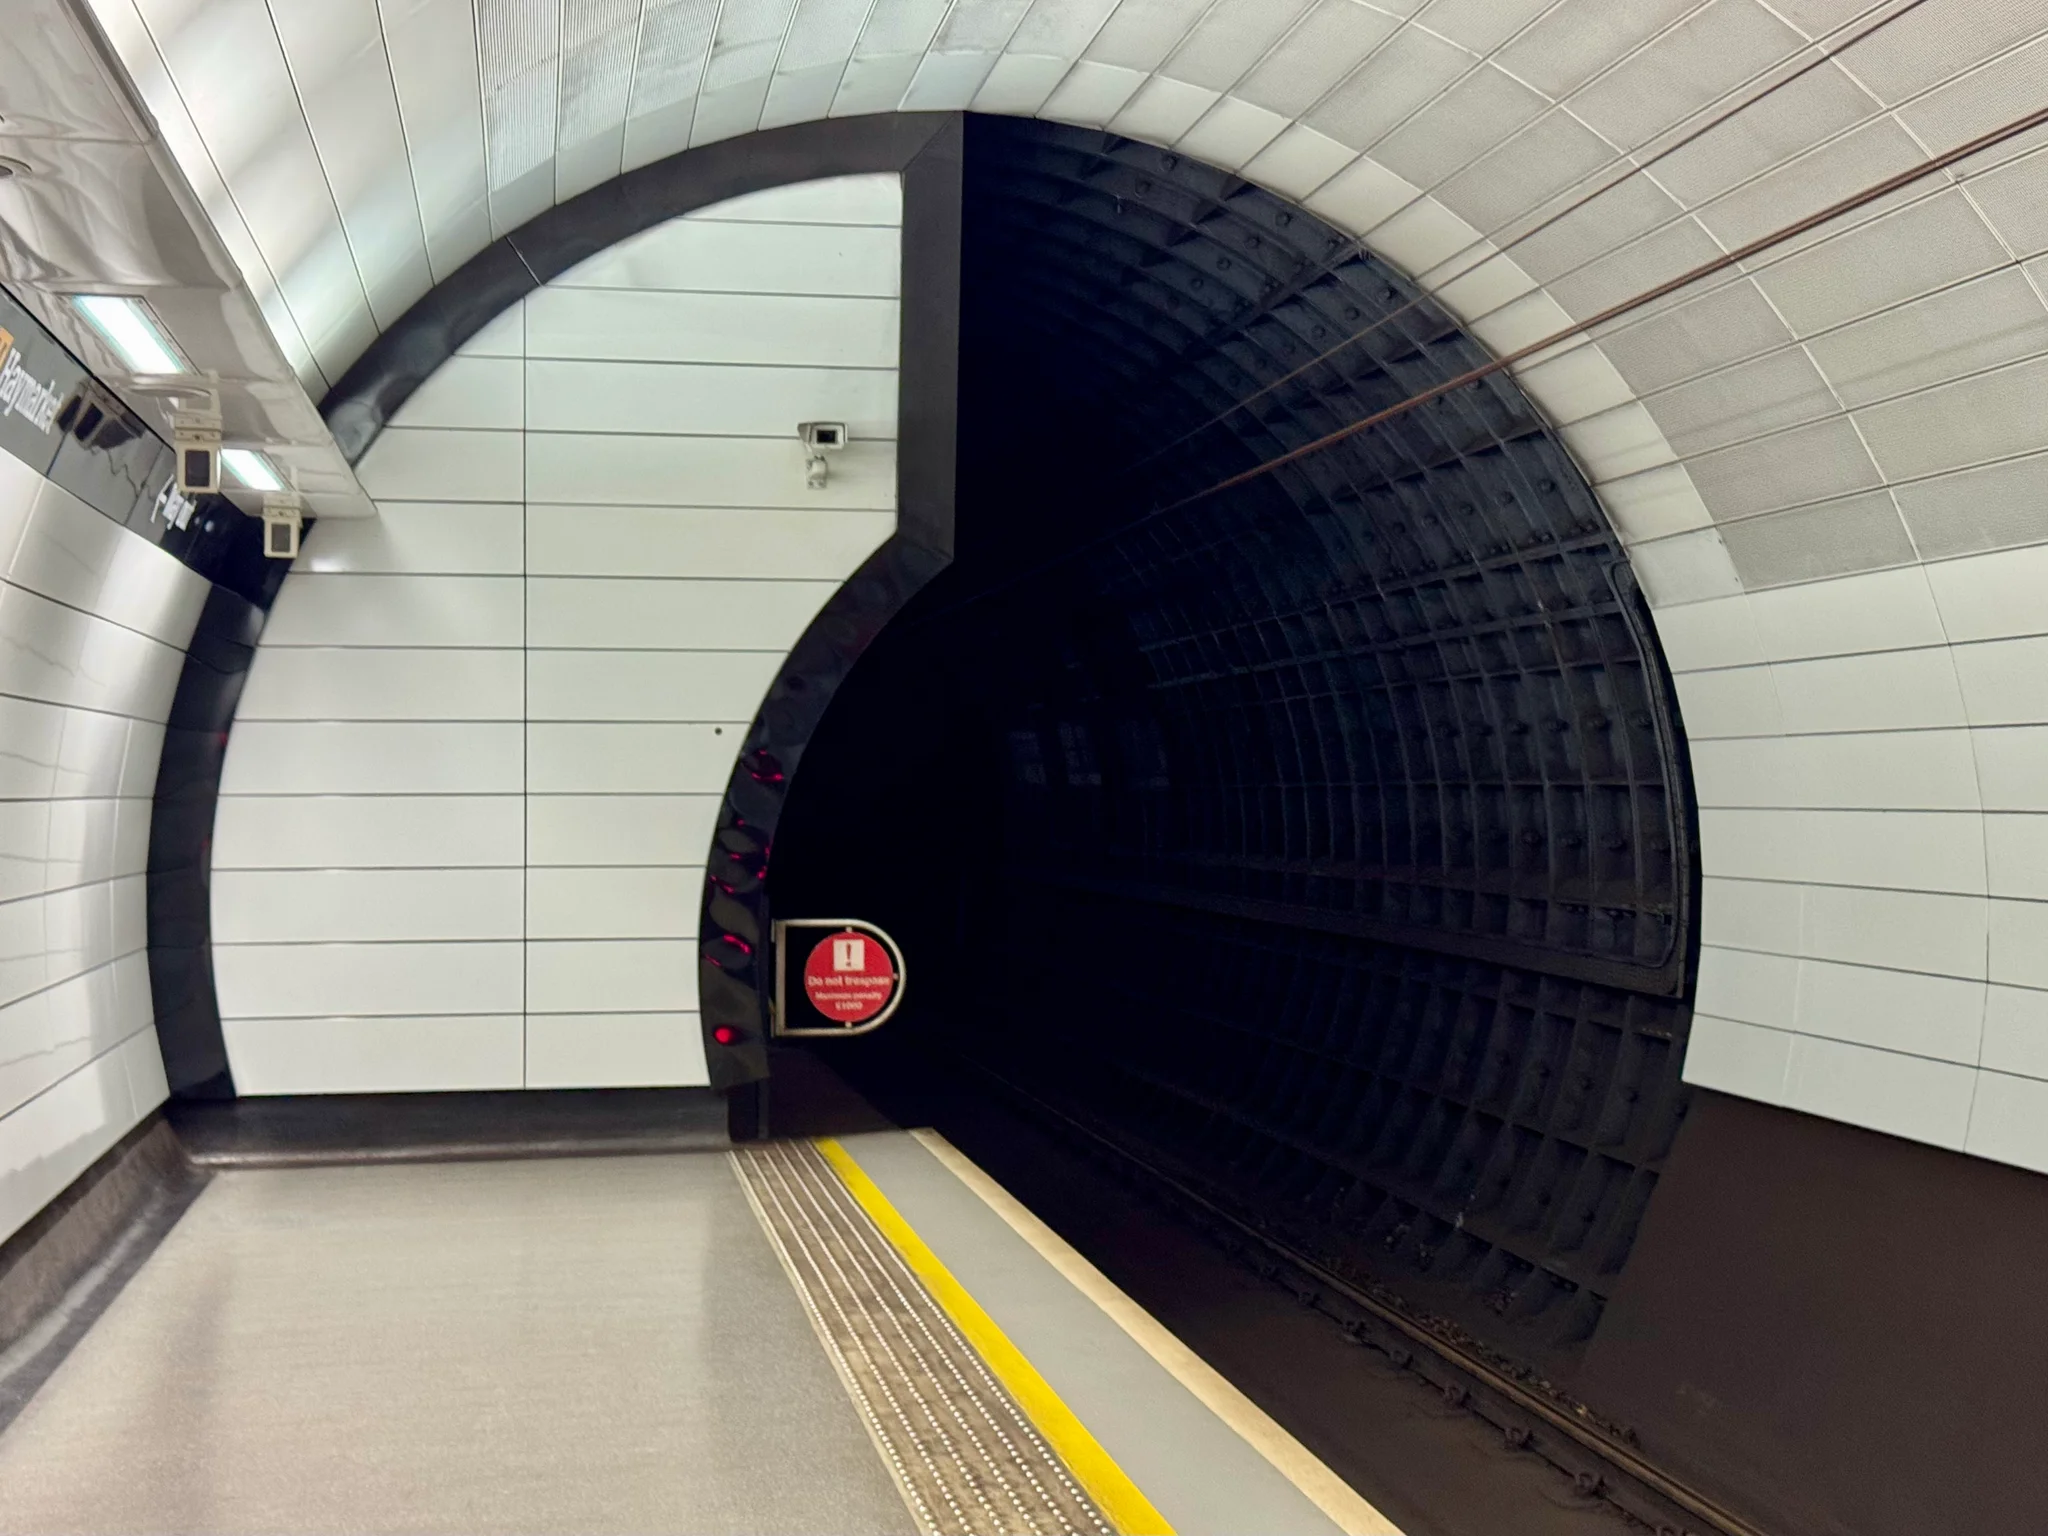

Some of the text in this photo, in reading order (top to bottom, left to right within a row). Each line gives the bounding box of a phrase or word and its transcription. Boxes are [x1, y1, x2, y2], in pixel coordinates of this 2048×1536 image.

[807, 975, 890, 987] Do not trespass
